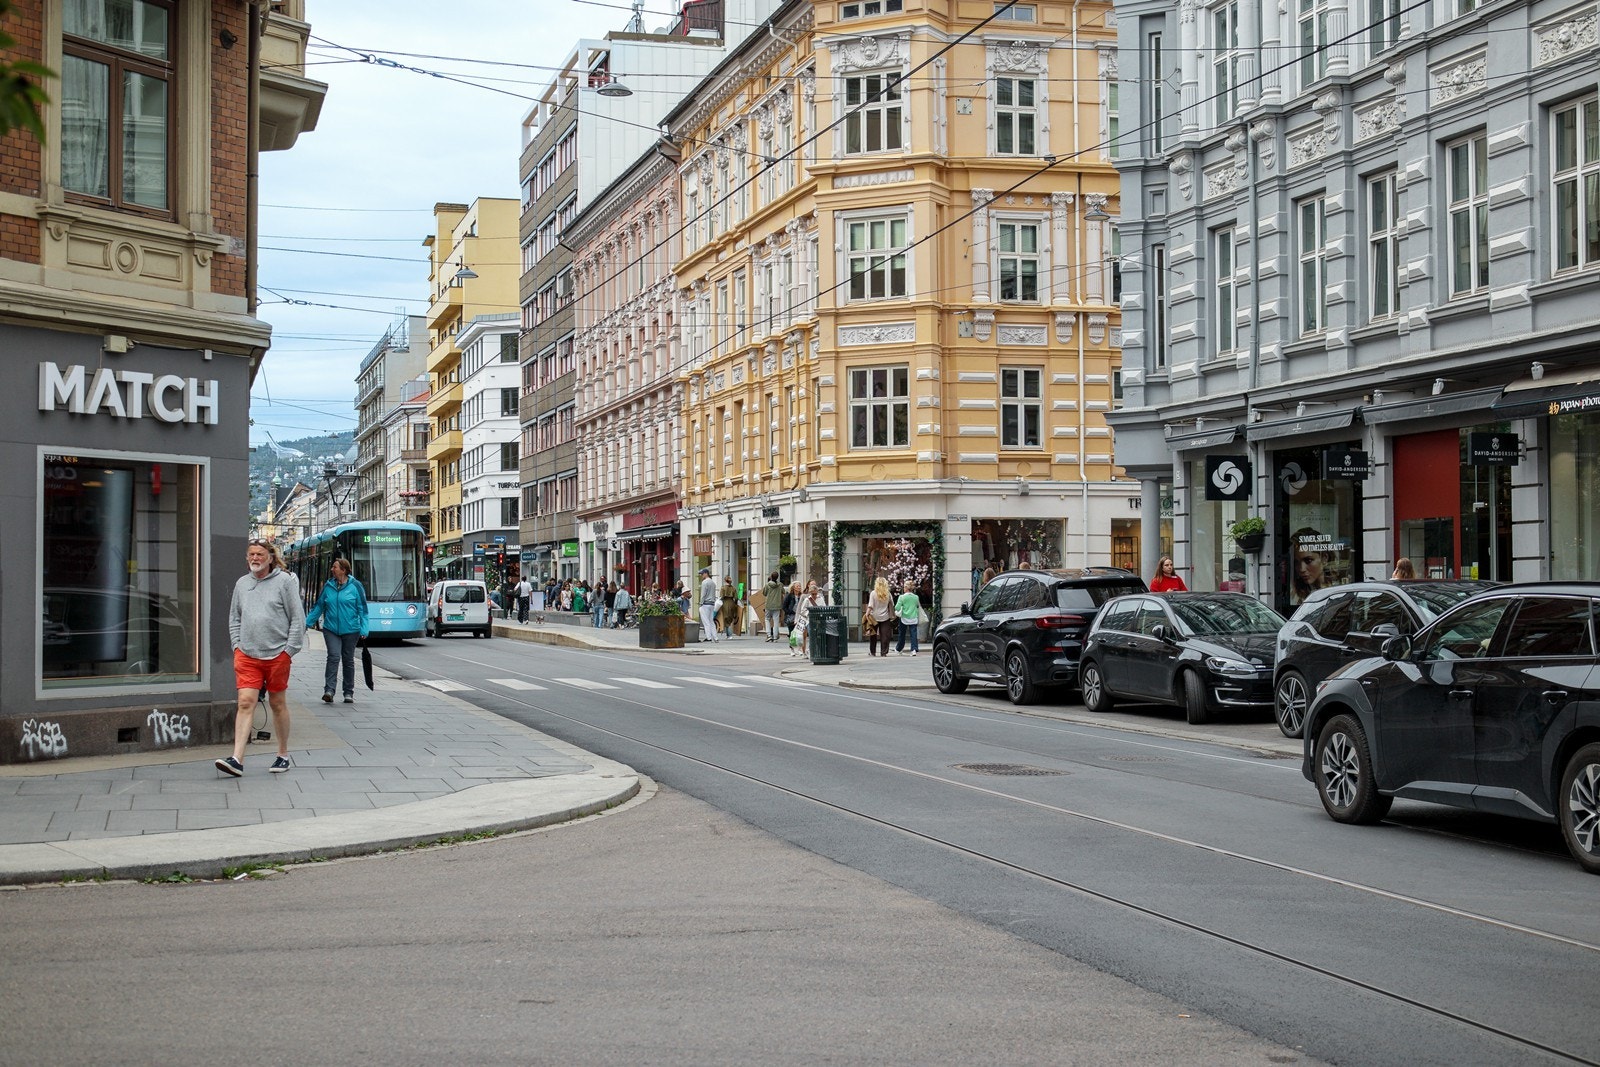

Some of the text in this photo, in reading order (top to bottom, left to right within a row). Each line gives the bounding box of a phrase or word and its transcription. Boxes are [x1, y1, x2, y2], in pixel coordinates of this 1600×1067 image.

[39, 361, 219, 425] MATCH
[1127, 497, 1142, 509] TR
[363, 535, 371, 543] 19
[379, 607, 395, 615] 453
